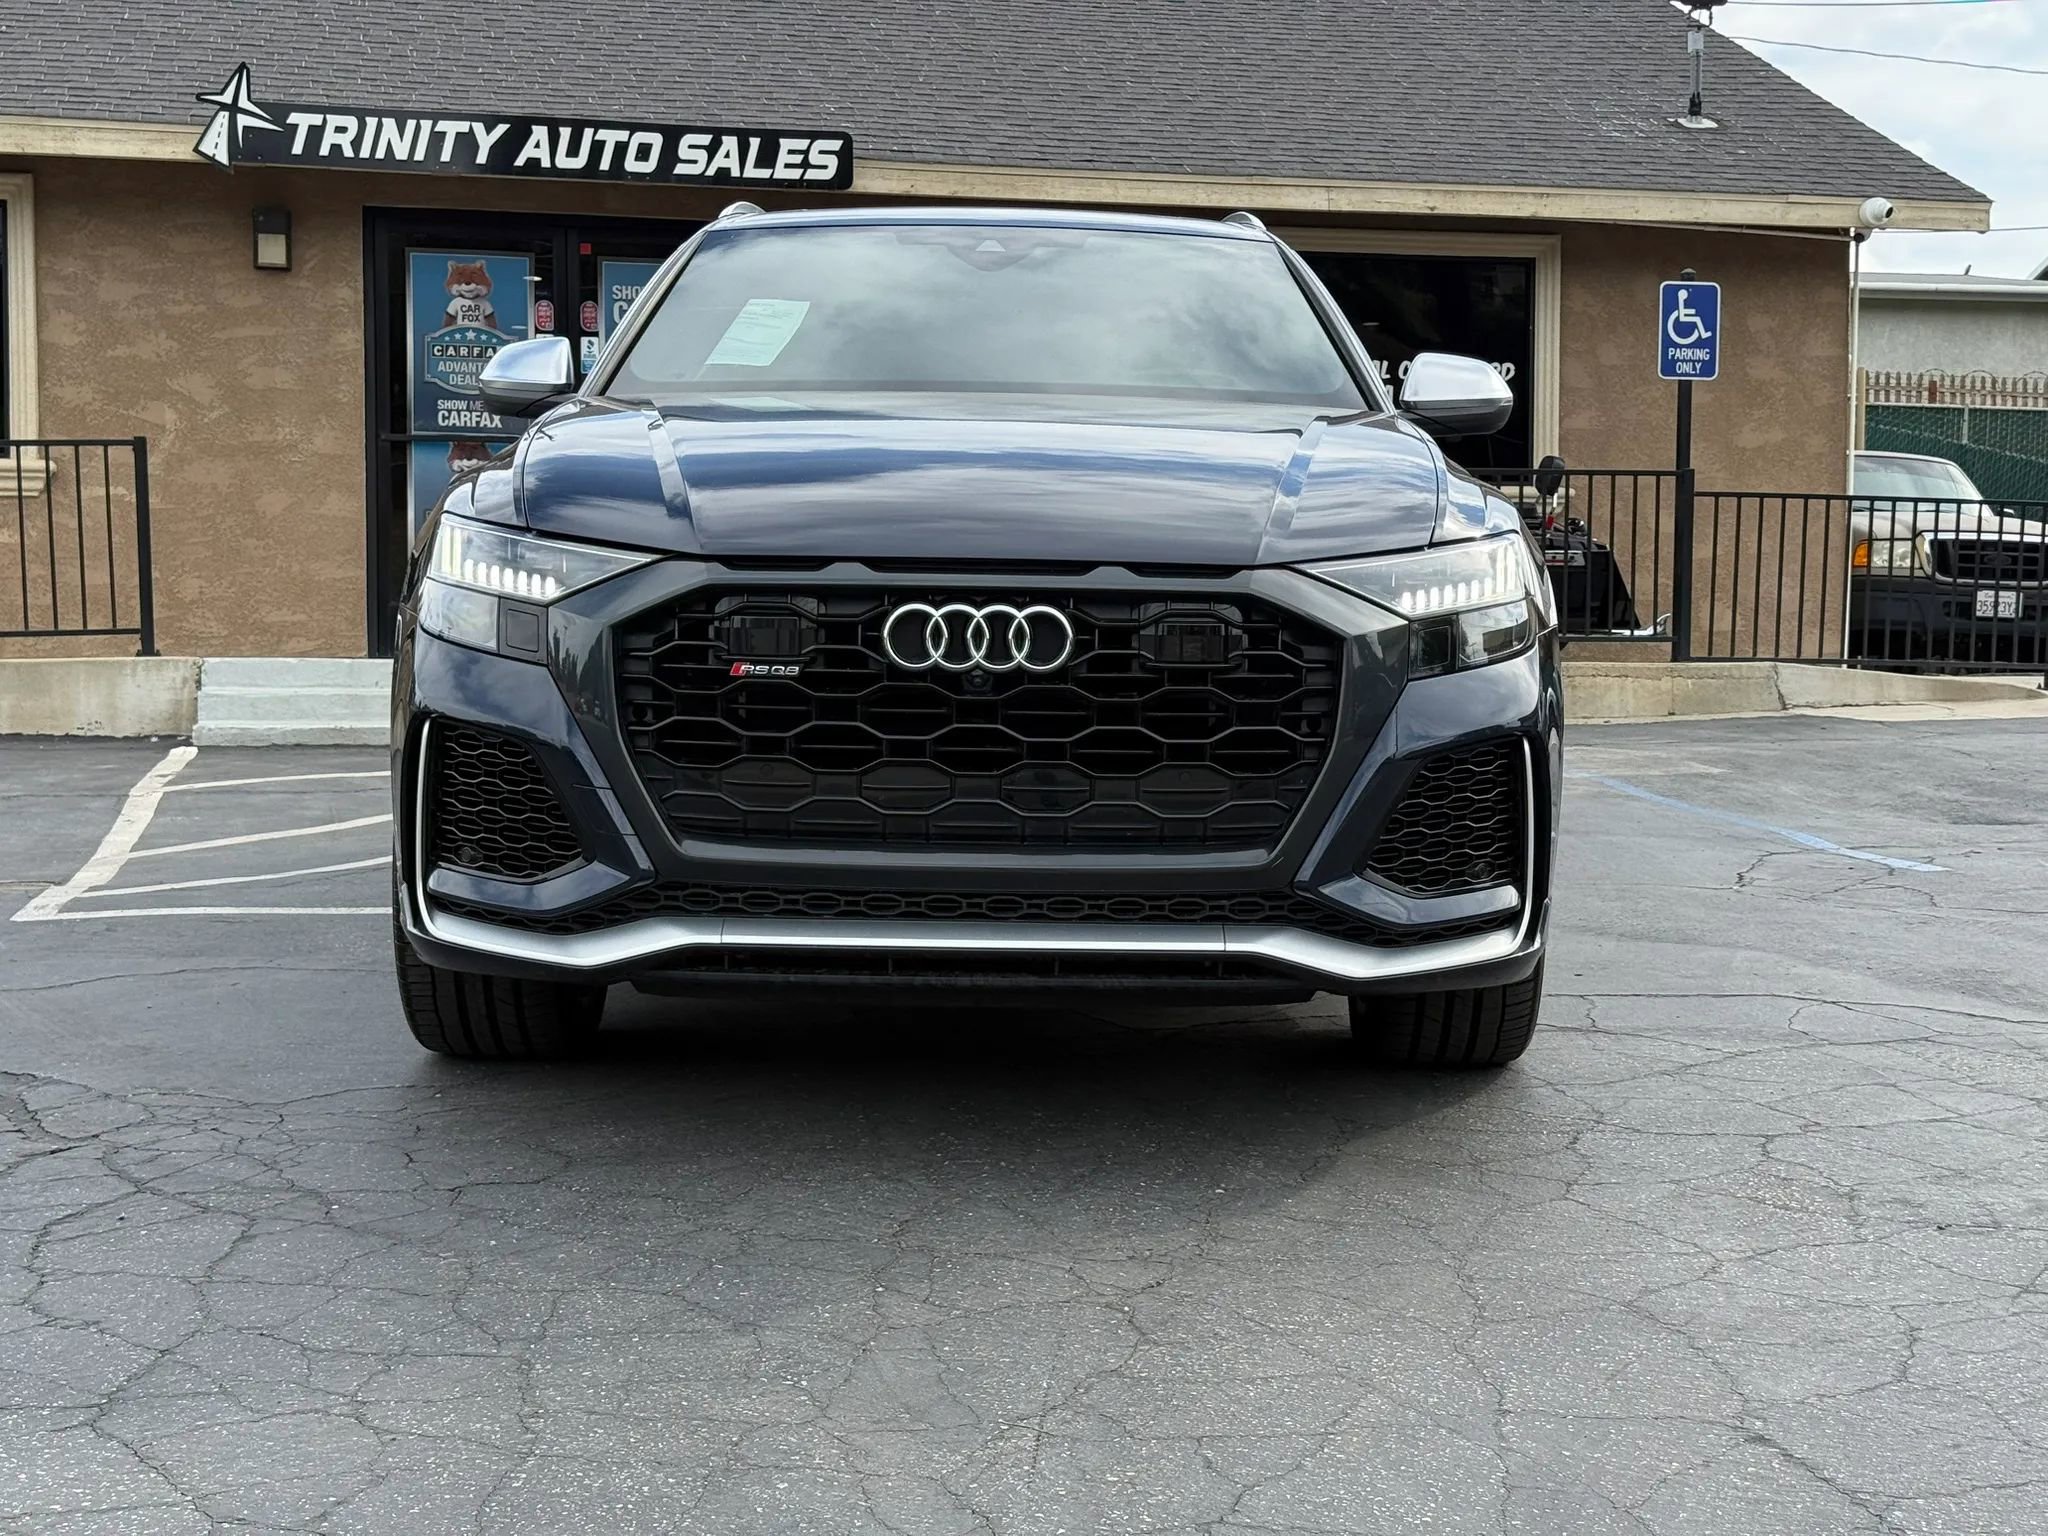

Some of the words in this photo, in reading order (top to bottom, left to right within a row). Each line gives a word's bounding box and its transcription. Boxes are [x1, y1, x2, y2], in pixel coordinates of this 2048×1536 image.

[286, 111, 511, 165] TRINITY
[513, 125, 664, 174] AUTO
[672, 133, 844, 181] SALES
[612, 284, 646, 300] SHO
[460, 304, 480, 314] CAR
[462, 314, 480, 323] FOX
[433, 345, 500, 358] CARFA
[1668, 347, 1711, 360] PARKING
[437, 361, 488, 372] ADVANT
[1675, 361, 1703, 374] ONLY
[449, 374, 483, 387] DEAL
[437, 399, 468, 411] SHOW
[469, 401, 485, 411] ME
[437, 410, 503, 428] CARFAX
